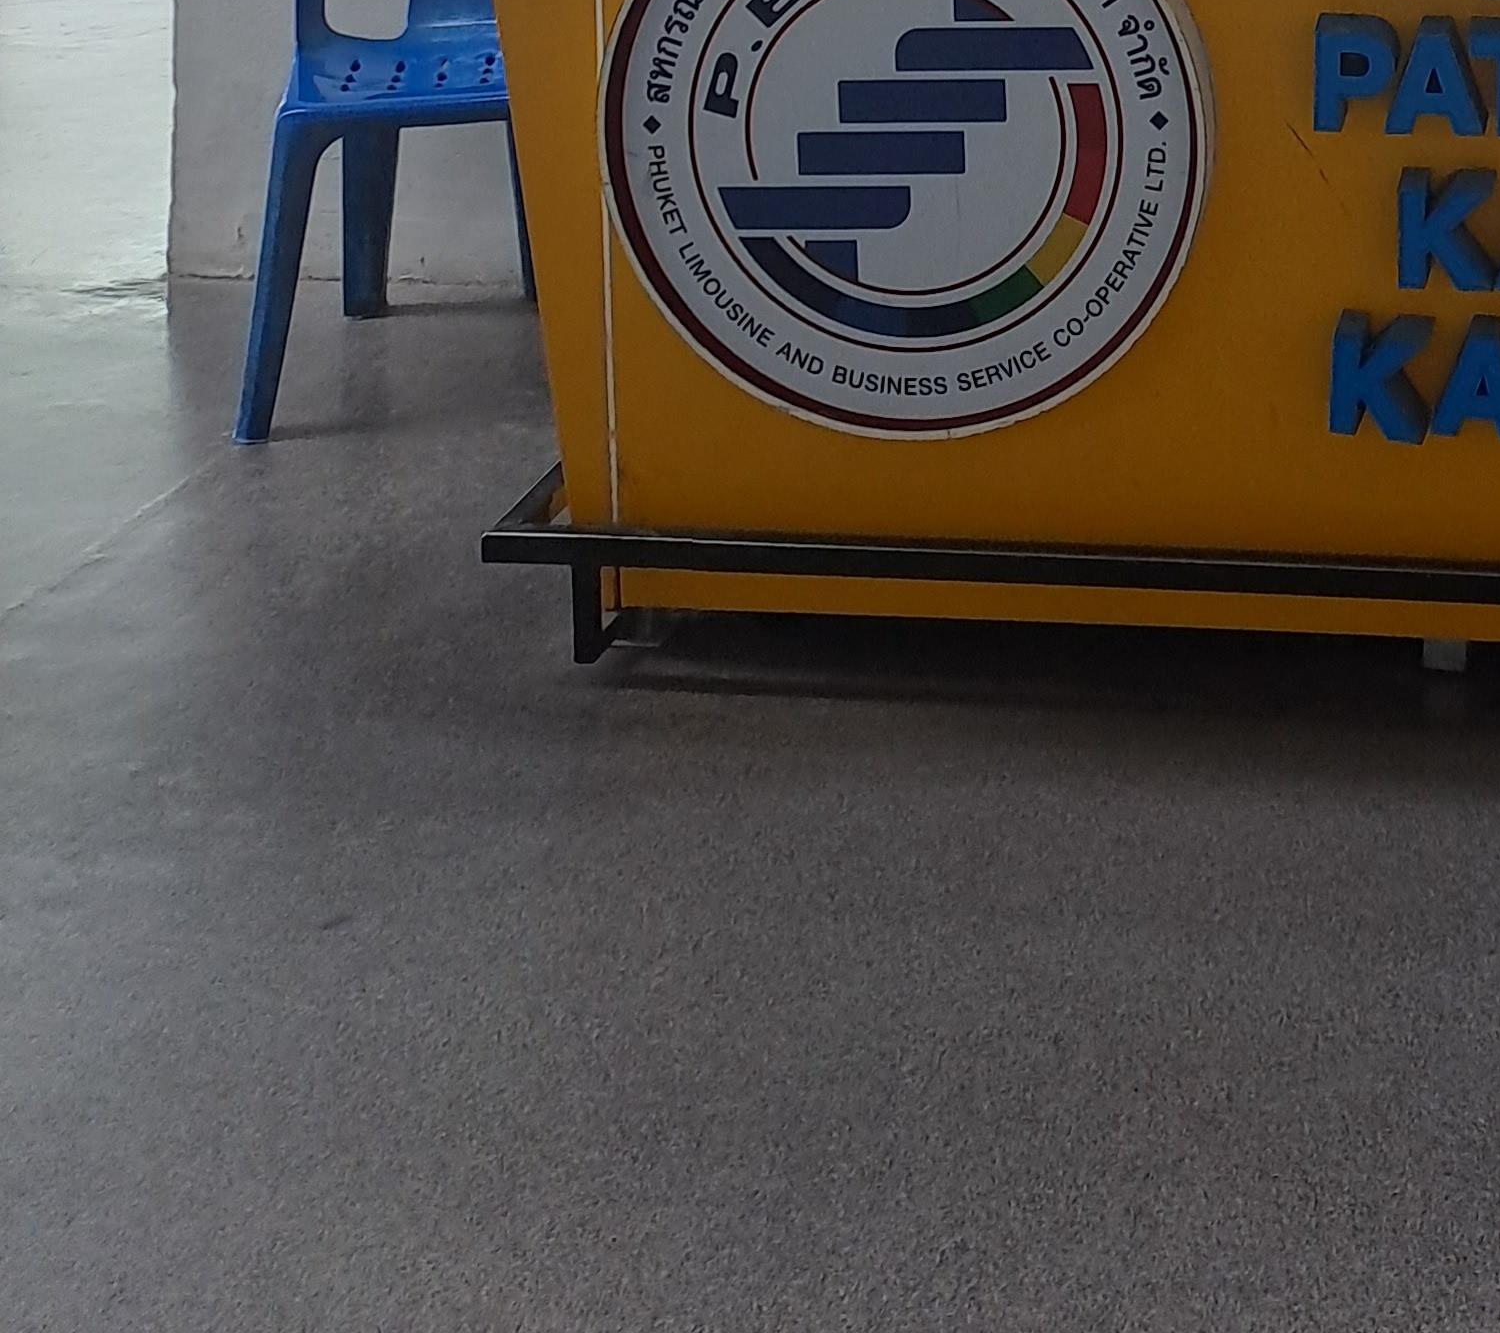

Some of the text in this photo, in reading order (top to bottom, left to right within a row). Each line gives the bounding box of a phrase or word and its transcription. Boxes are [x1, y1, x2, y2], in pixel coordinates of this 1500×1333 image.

[647, 139, 1169, 397] PHUKET LIMOUSINE AND BUSINESS SERVICE CO-OPERATIVE LTD.
